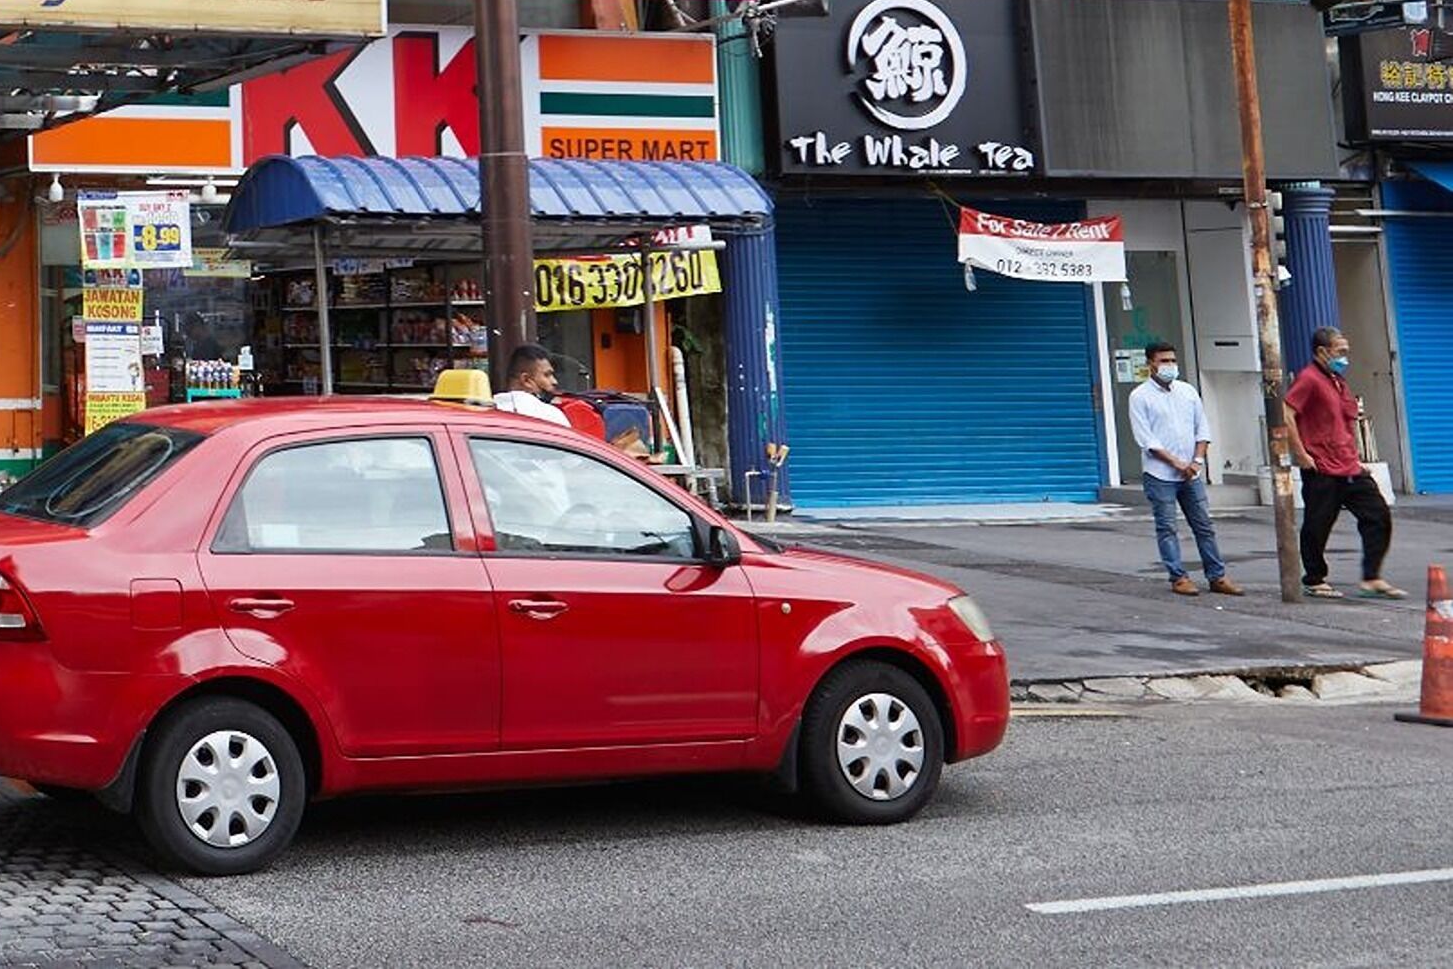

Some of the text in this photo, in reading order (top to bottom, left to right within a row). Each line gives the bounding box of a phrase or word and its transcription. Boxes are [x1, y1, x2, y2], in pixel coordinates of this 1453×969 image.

[549, 137, 712, 162] SUPER MART
[789, 131, 1036, 171] The Whale Tea
[975, 212, 1009, 235] For
[1009, 218, 1053, 239] Sale
[1065, 220, 1114, 240] Rent
[84, 289, 140, 305] JAWATAN
[87, 305, 138, 320] KOSONG
